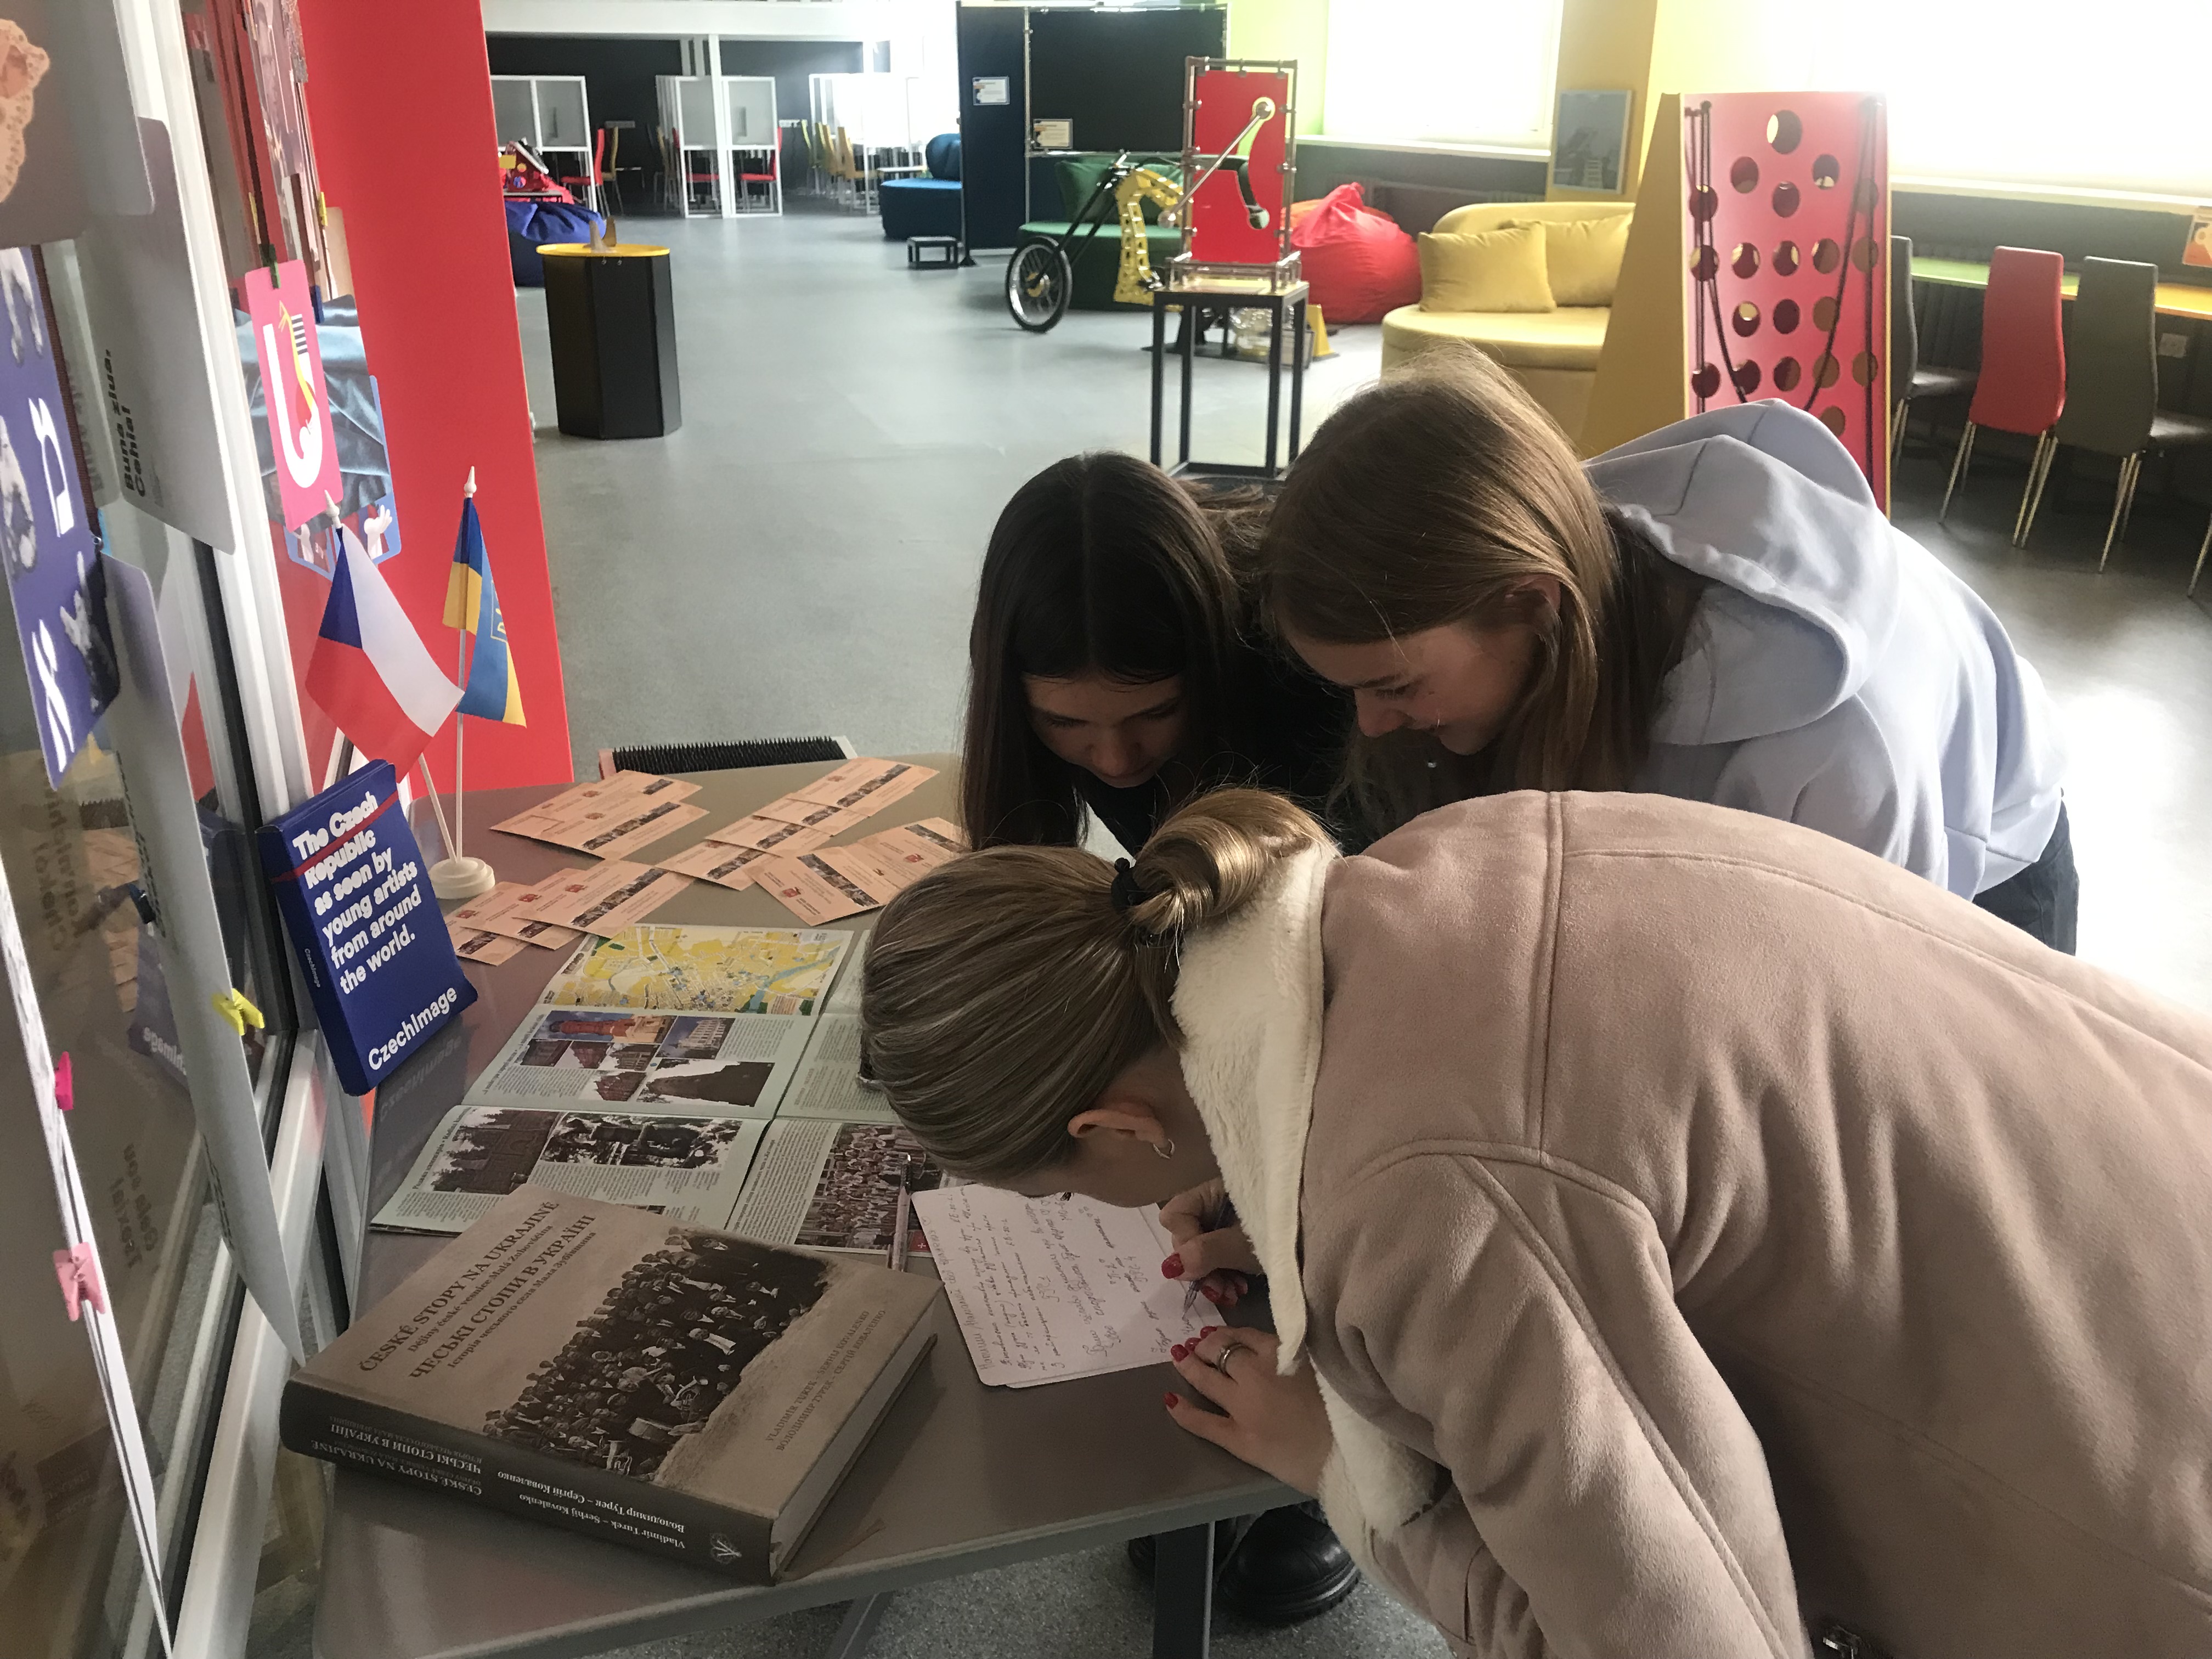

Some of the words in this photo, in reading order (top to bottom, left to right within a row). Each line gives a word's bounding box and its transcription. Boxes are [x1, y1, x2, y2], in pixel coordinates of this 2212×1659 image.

[292, 828, 329, 860] The
[329, 791, 379, 838] Czech
[304, 830, 376, 889] Republic
[314, 891, 333, 916] as
[333, 864, 373, 901] seen
[371, 847, 392, 874] by
[322, 894, 373, 947] young
[374, 861, 417, 905] artists
[331, 930, 369, 969] from
[370, 883, 422, 938] around
[340, 965, 366, 995] the
[366, 923, 415, 972] world.
[368, 987, 457, 1070] CzechImage
[359, 1325, 418, 1370] ČESKÉ
[413, 1281, 465, 1324] STOPY
[461, 1263, 490, 1280] NA
[484, 1202, 558, 1260] UKRAJINĚ
[410, 1325, 475, 1377] ЧЕСЬКІ
[471, 1277, 527, 1323] СТОПИ
[521, 1266, 538, 1276] В
[532, 1216, 595, 1264] УКРАЇНІ
[765, 1406, 798, 1441] VLADIMÍR
[794, 1380, 817, 1403] TUREK
[836, 1311, 869, 1348] KOVALENKO
[776, 1403, 815, 1451] ВОЛОДИМИР
[811, 1380, 833, 1402] ТУРЕК
[853, 1310, 885, 1349] КОВАЛЕНКО
[331, 1424, 379, 1444] УКРАЇНІ
[381, 1438, 389, 1447] В
[393, 1441, 433, 1459] СТОПИ
[377, 1458, 394, 1470] NA
[398, 1465, 437, 1482] STOPY
[437, 1454, 480, 1473] ЧЕСЬКІ
[441, 1477, 482, 1495] ČESKÉ
[498, 1471, 550, 1493] Коваленко
[519, 1494, 568, 1514] Kovalenko
[552, 1487, 584, 1503] Сергій
[571, 1508, 600, 1523] Serhij
[595, 1500, 624, 1515] Турек
[611, 1520, 637, 1534] Turek
[627, 1508, 684, 1532] Володимир
[641, 1530, 685, 1548] Vladimír
